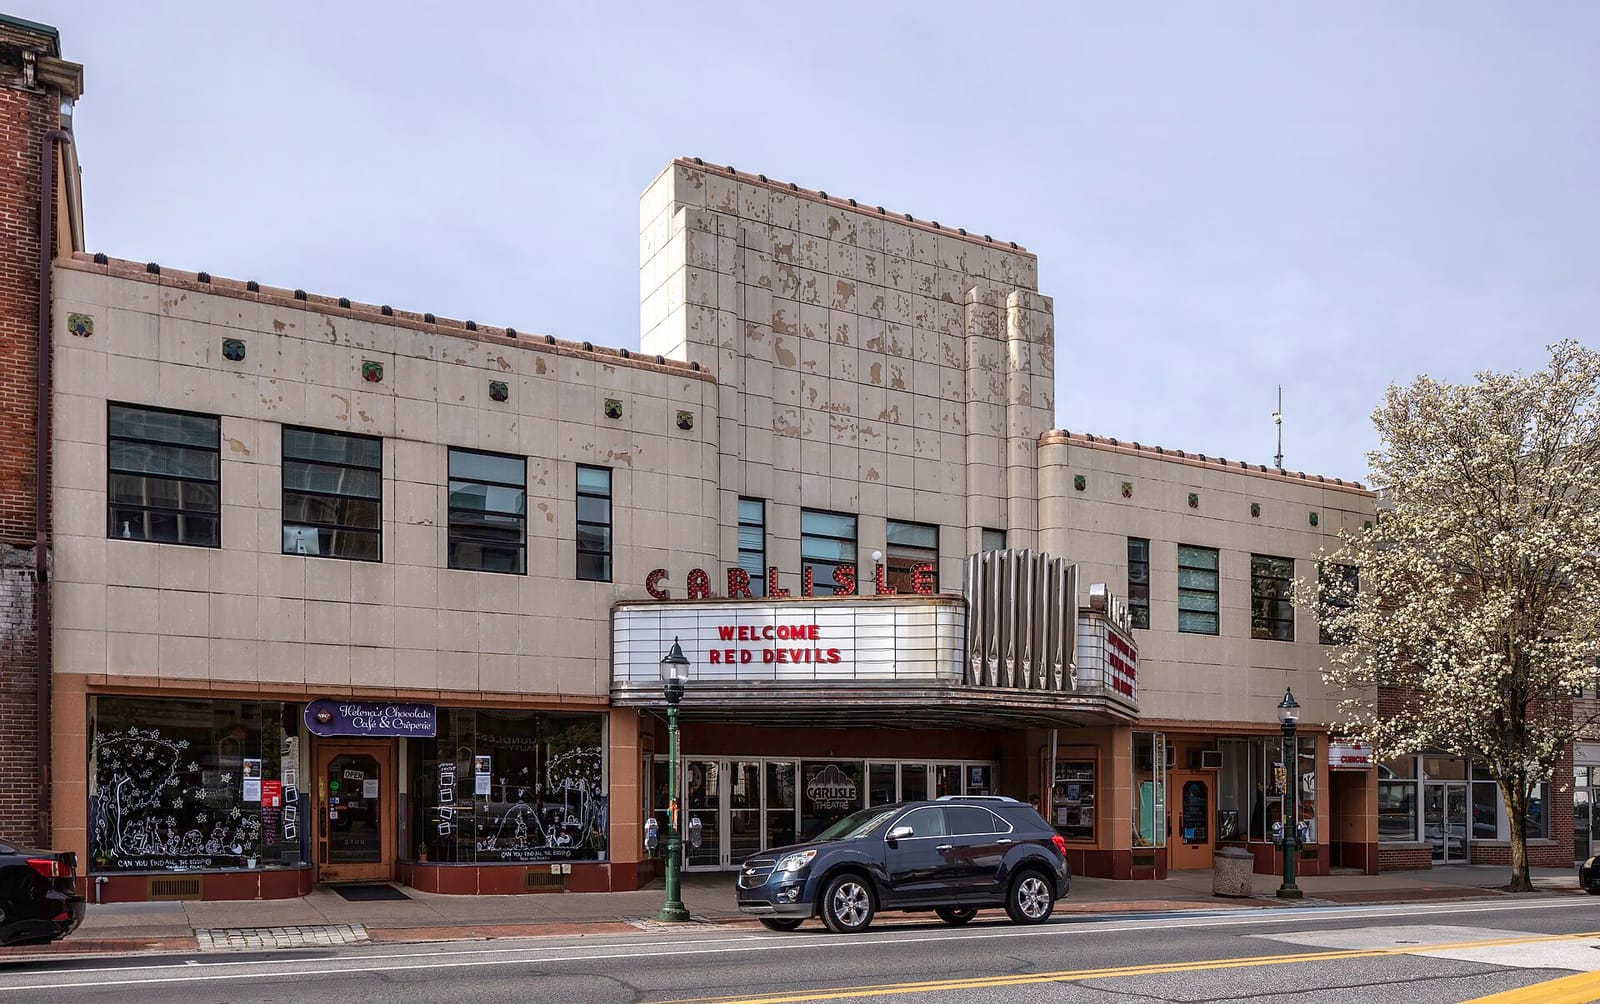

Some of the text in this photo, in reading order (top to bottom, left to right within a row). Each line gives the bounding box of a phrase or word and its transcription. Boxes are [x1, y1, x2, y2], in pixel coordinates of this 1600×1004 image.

[645, 562, 933, 600] CARLISLE
[718, 624, 821, 640] WELCOME
[709, 648, 842, 664] RED DEVILS
[339, 704, 383, 717] Helena's
[385, 706, 432, 719] Chocolate
[352, 715, 432, 732] Café & Crêperie
[345, 770, 363, 780] OPEN
[807, 786, 857, 800] CARLISLE
[815, 801, 849, 810] THEATRE
[117, 860, 133, 868] CAN
